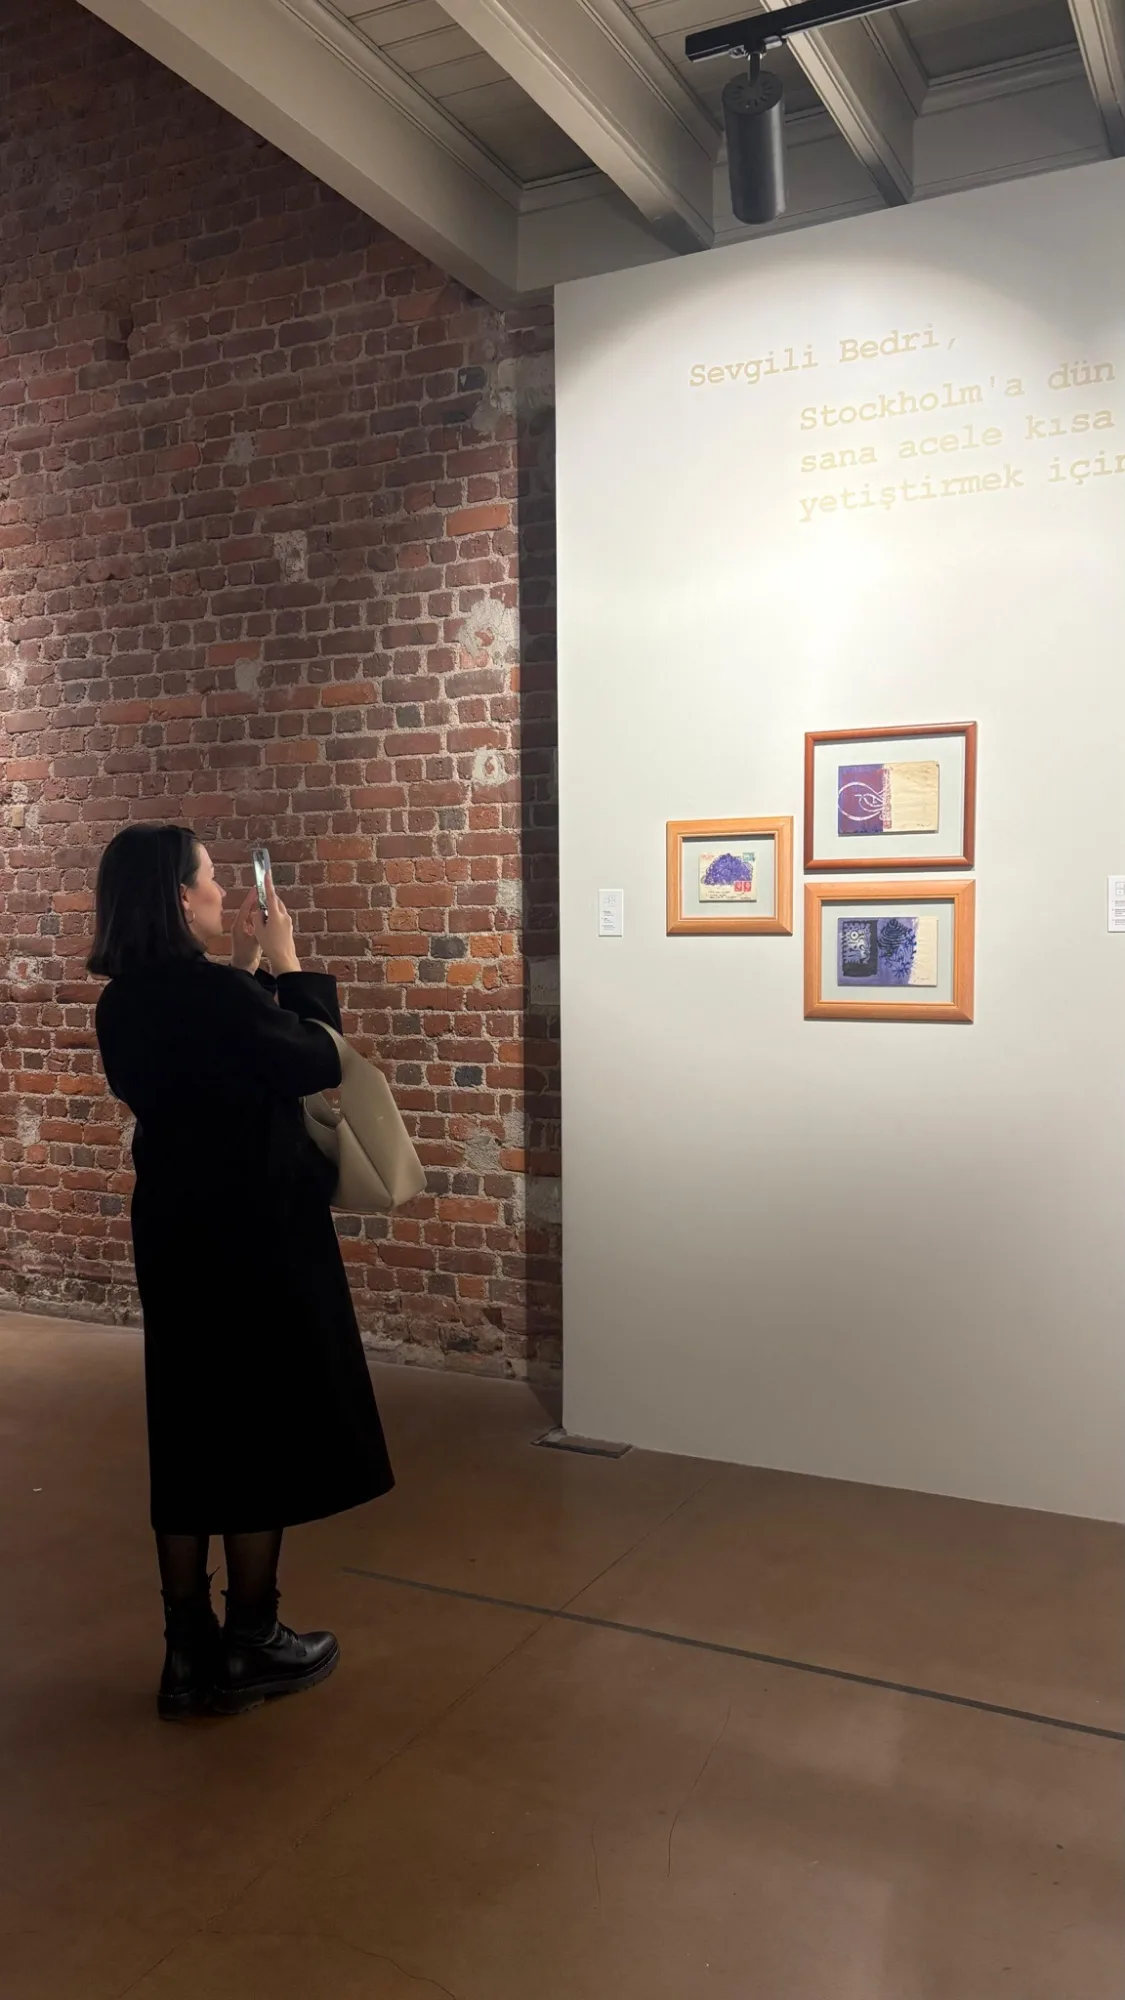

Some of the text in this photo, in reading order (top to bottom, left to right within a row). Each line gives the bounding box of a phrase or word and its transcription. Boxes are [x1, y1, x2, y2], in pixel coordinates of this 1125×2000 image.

[689, 323, 957, 387] Sevgili Bedri,
[800, 360, 1116, 431] Stockholm'a dün
[800, 408, 1115, 474] sana acele kısa
[798, 463, 1024, 523] yetiştirmek
